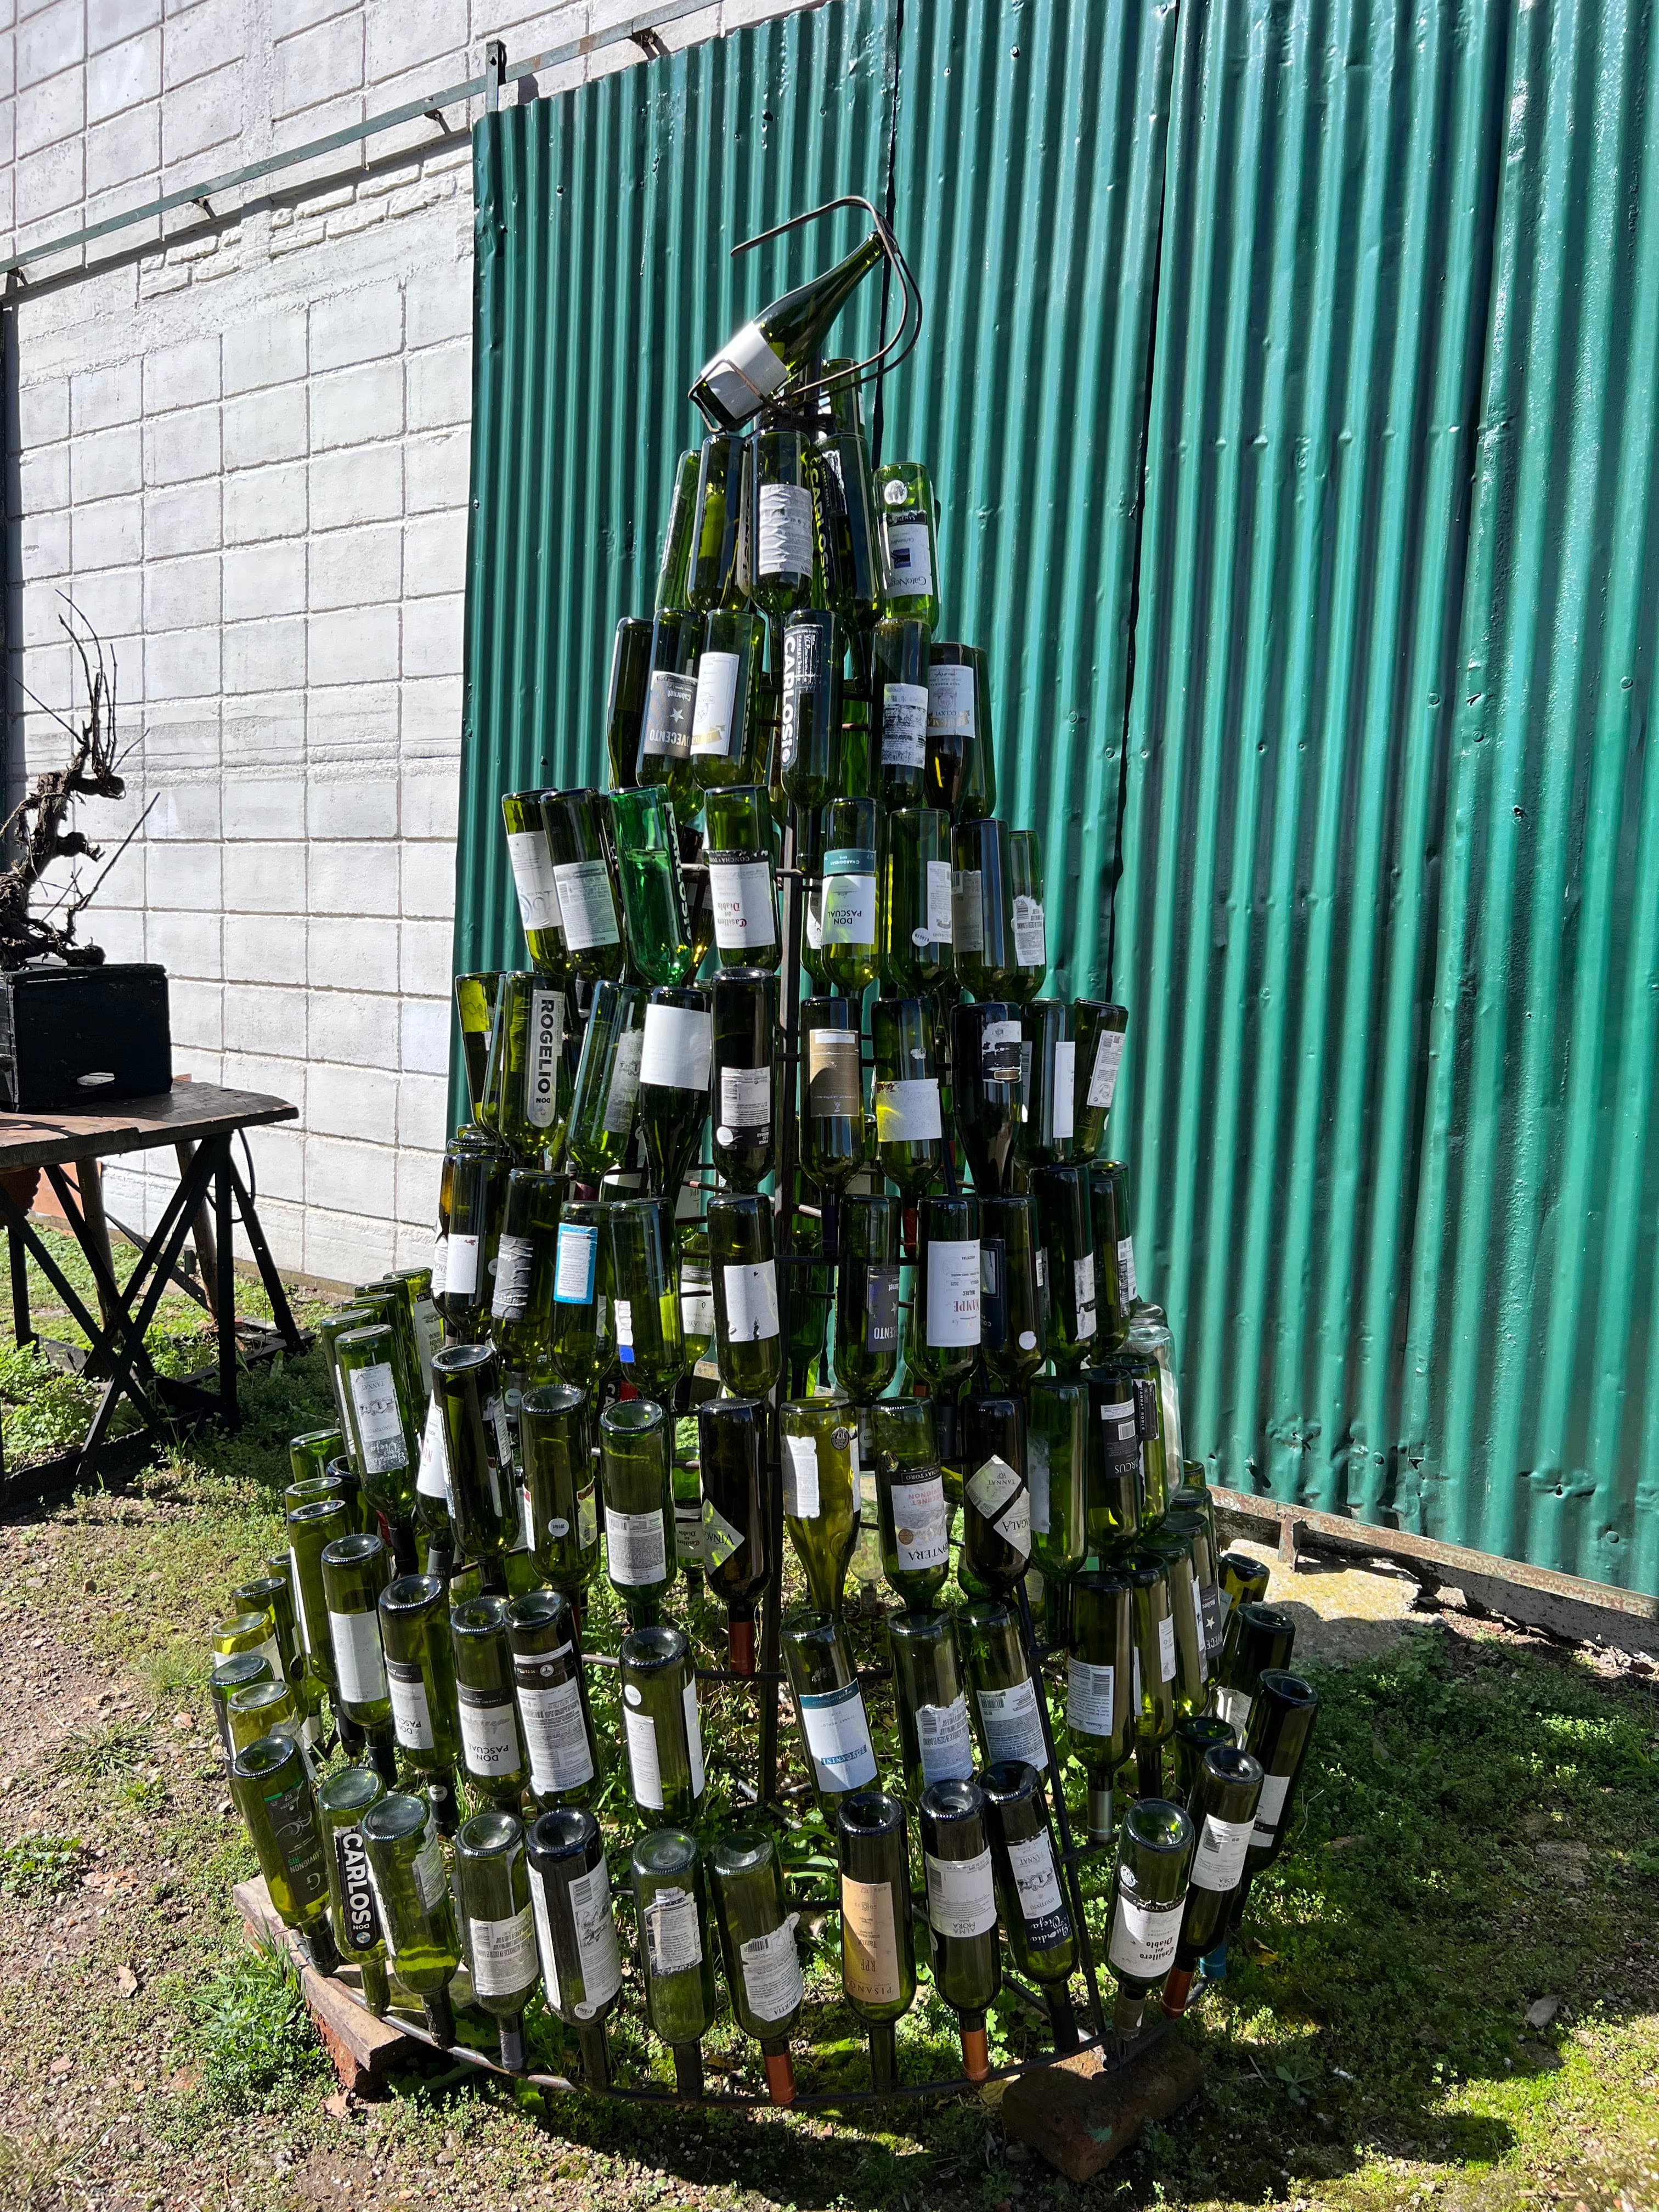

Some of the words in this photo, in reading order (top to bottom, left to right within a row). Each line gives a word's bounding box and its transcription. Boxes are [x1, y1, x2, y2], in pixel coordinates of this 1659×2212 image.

[782, 636, 796, 738] CARLOS
[667, 690, 691, 702] Cabernet
[649, 729, 691, 747] OVECENTO
[669, 811, 688, 917] CARLOS
[827, 910, 862, 918] PASCUAL
[538, 999, 554, 1094] ROGELIO
[361, 1380, 385, 1391] TANNAT
[704, 1531, 735, 1546] VIÑAG
[908, 1542, 949, 1561] ONTERA
[467, 1742, 509, 1755] PASCUAL
[822, 1747, 866, 1765] TOSCANINI
[476, 1753, 499, 1762] DON
[287, 1856, 301, 1866] RIS
[289, 1847, 323, 1874] SAUVIGNON
[1019, 1852, 1045, 1866] TANNAT
[342, 1833, 372, 1925] CARLOS
[1030, 1915, 1064, 1931] Vieja
[1146, 1936, 1173, 1949] Diablo
[1139, 1946, 1174, 1961] Casillero
[860, 1959, 876, 1972] RPF
[850, 1980, 891, 1995] PISANO
[773, 1995, 798, 2016] IRURTIA
